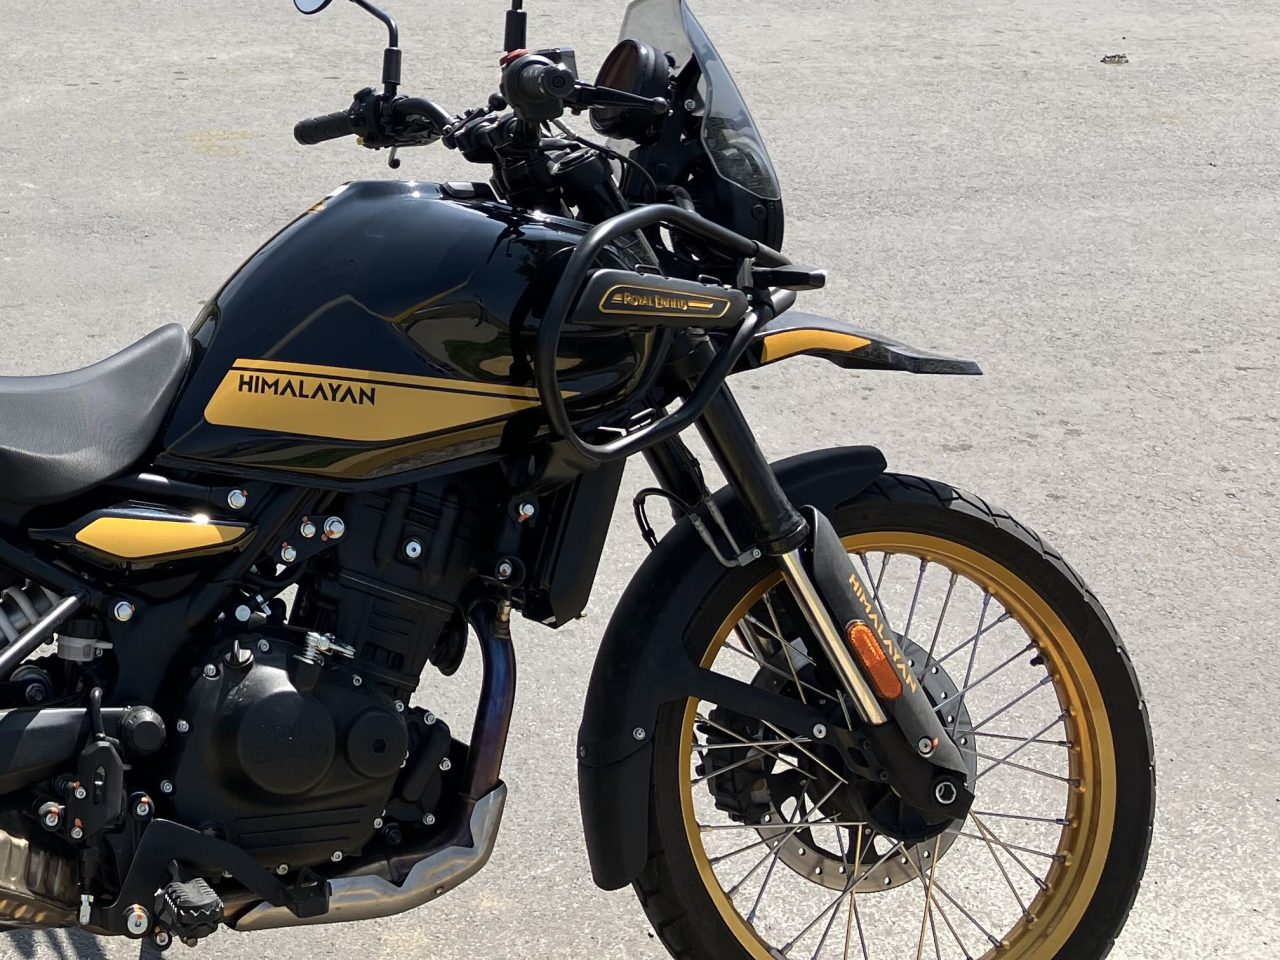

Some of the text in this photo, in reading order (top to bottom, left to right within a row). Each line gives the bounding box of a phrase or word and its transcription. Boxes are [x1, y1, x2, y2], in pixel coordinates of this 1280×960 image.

[623, 292, 688, 310] ROYAL ENFIELD
[238, 374, 376, 406] HIMALAYAN
[849, 573, 917, 694] HIMALAYAN
